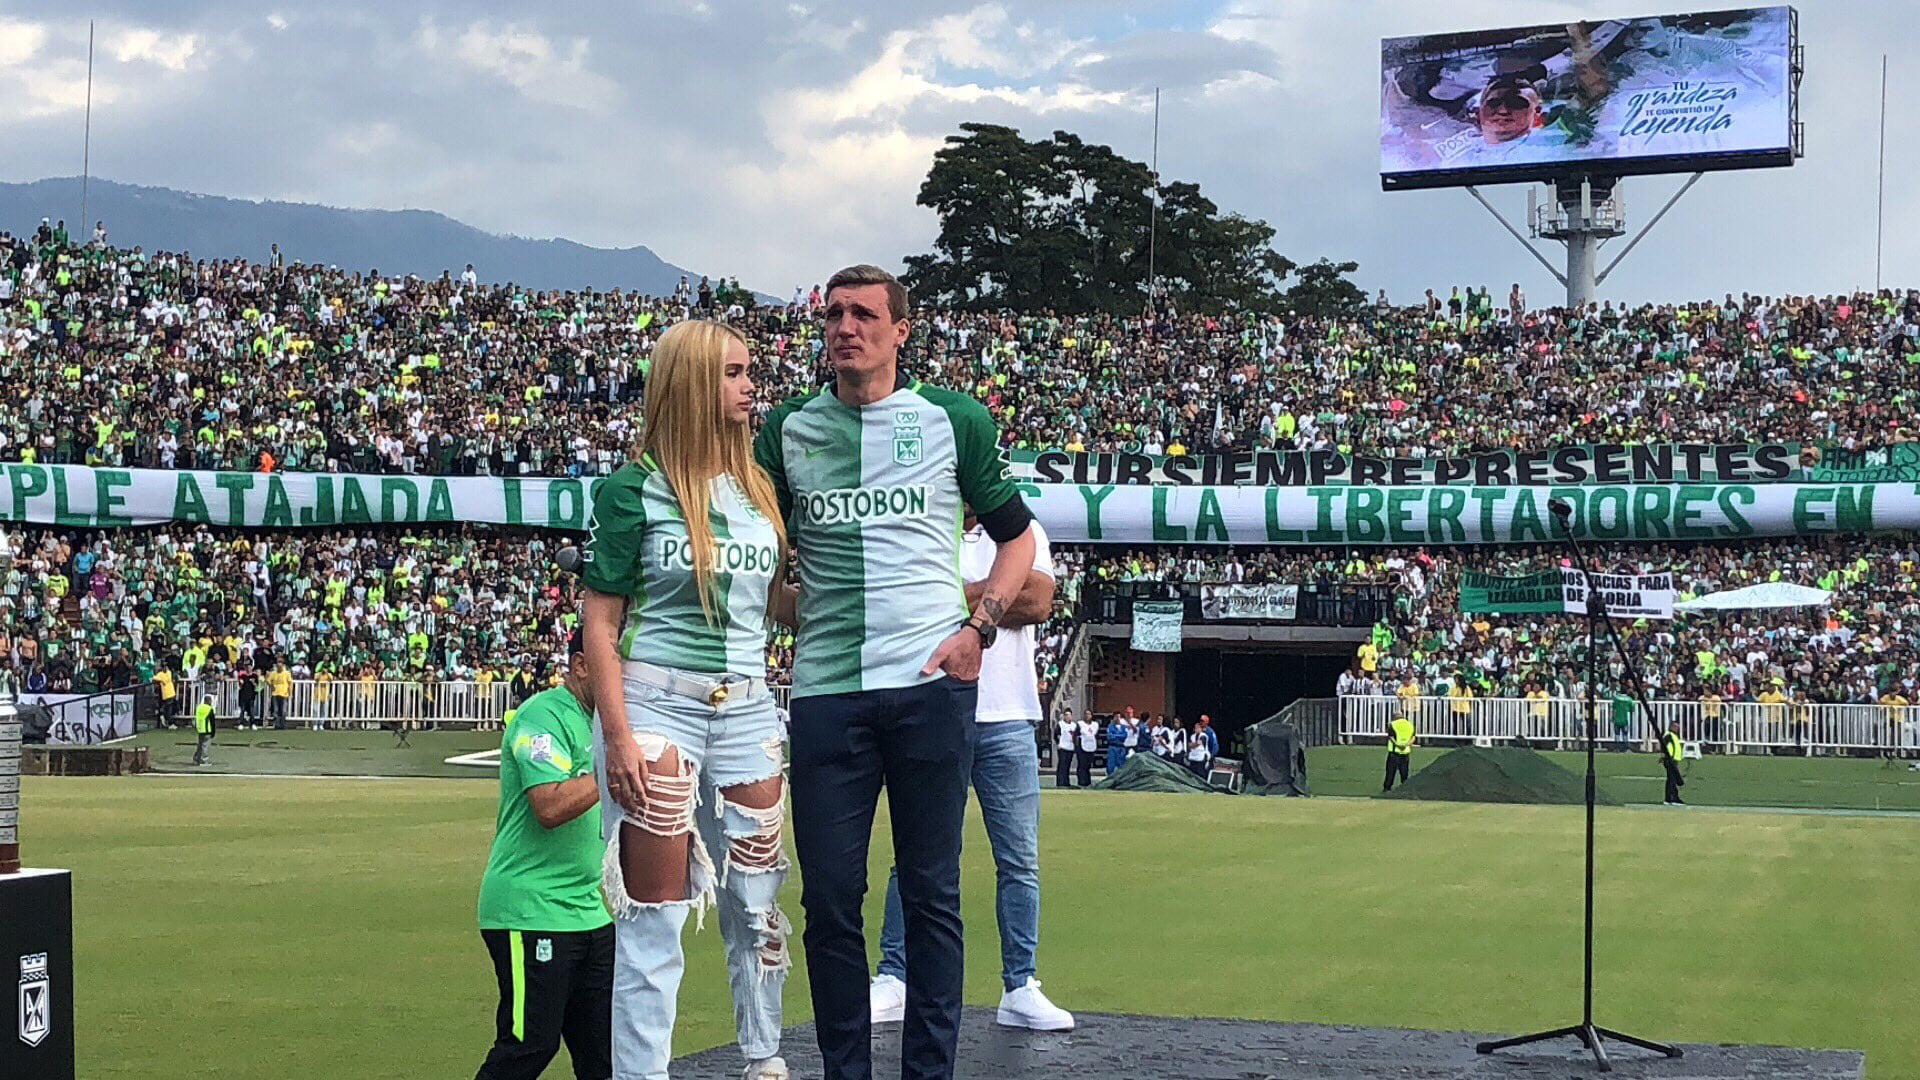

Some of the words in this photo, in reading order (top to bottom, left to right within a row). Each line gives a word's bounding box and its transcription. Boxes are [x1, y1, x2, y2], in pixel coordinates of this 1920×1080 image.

[1625, 82, 1738, 118] grandeza
[1673, 81, 1689, 91] TU
[1620, 104, 1732, 145] leyenda
[1035, 452, 1150, 485] SUR
[1163, 450, 1424, 485] SIEMPRE
[1434, 444, 1791, 486] PRESENTES
[0, 464, 133, 526] PLE
[172, 472, 455, 527] ATAJADA
[504, 479, 608, 530] LO
[800, 486, 925, 522] POSTOBON
[1082, 485, 1115, 540] Y
[1152, 487, 1229, 542] LA
[1265, 485, 1755, 543] LIBERTADORES
[1793, 484, 1876, 534] EN
[664, 540, 779, 573] POTOBO
[1567, 588, 1584, 602] DE
[1638, 575, 1670, 590] PARA
